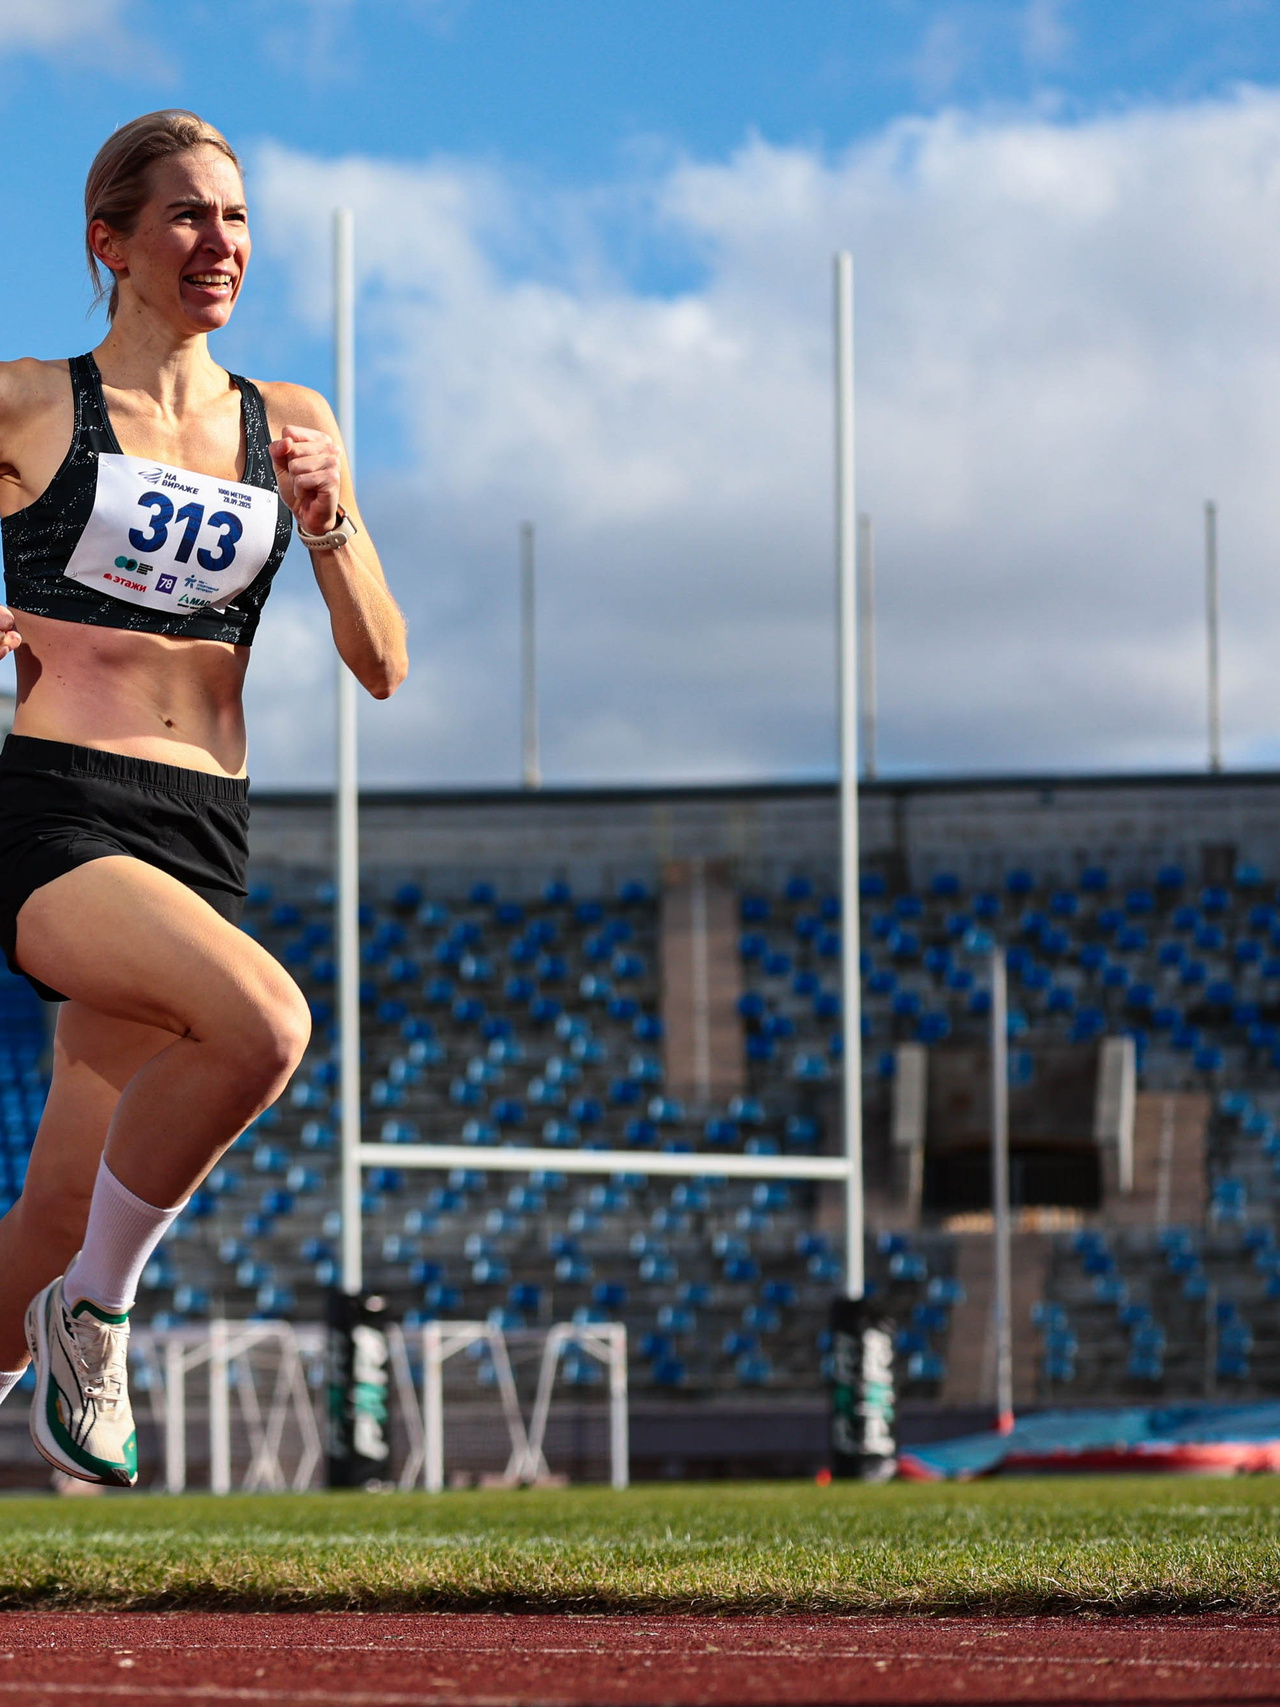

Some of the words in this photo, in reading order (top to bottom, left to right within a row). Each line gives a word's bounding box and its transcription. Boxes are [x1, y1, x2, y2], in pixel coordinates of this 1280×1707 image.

[164, 472, 177, 482] НА
[161, 479, 200, 495] ВИРАЖЕ
[230, 491, 252, 502] МЕТРОВ
[128, 491, 244, 572] 313
[158, 577, 173, 589] 78
